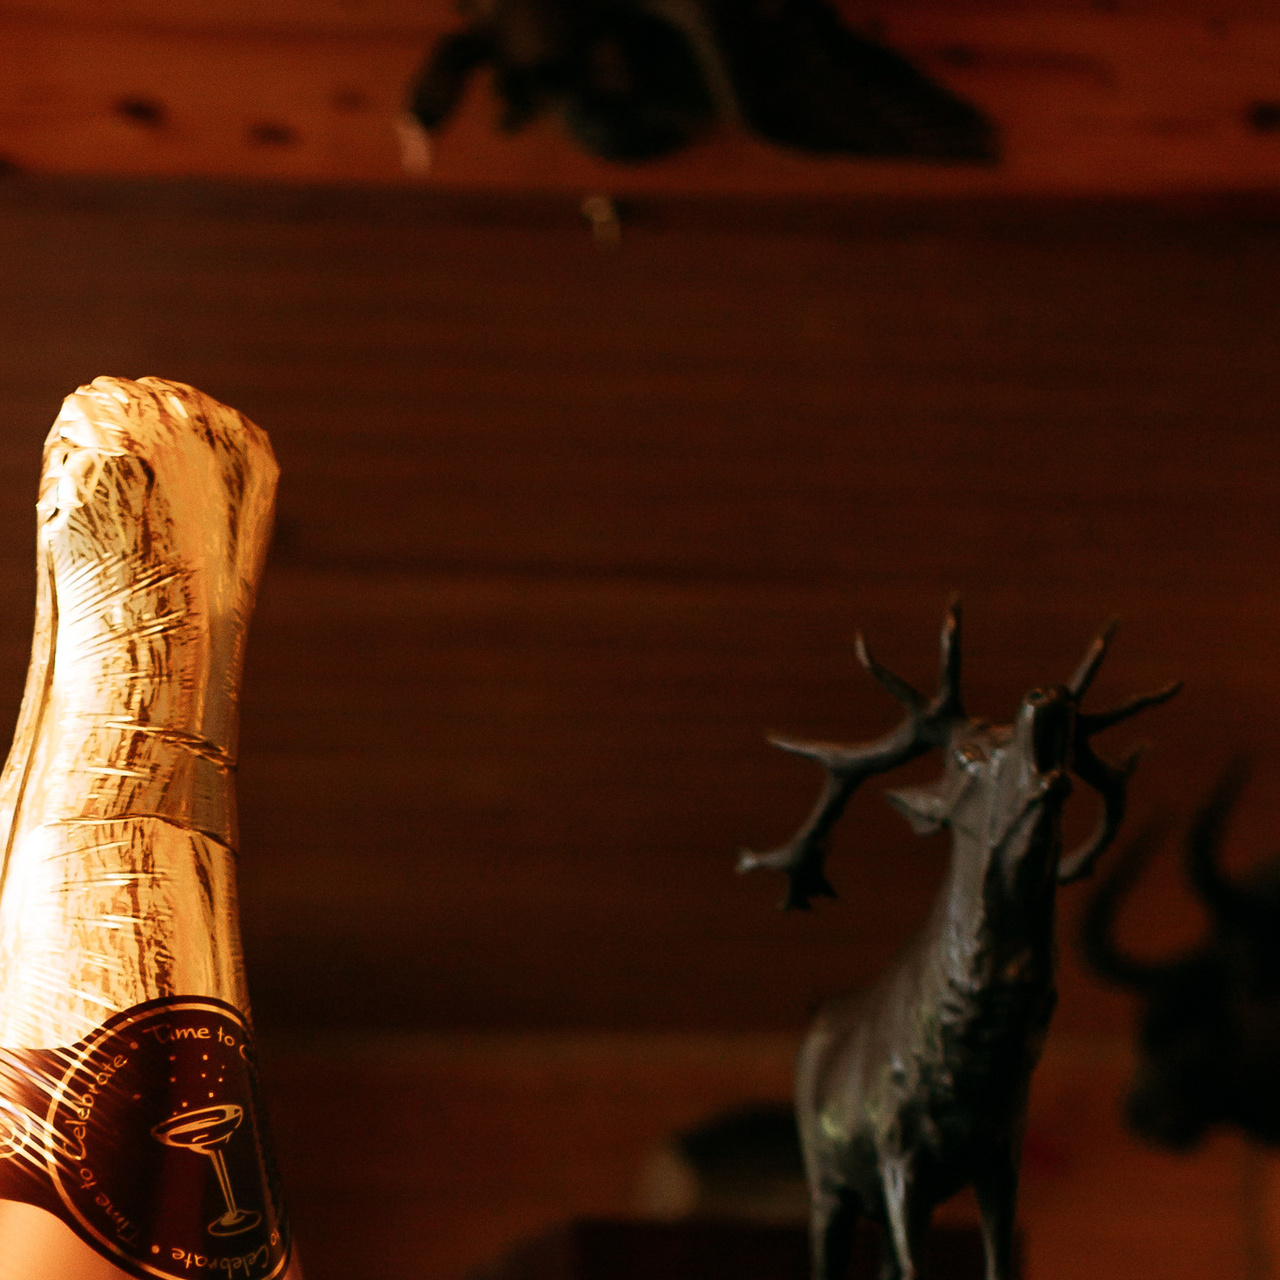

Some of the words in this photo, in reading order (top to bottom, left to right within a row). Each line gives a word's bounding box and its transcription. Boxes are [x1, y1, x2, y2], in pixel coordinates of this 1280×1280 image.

[217, 1026, 235, 1047] to
[63, 1054, 128, 1161] Celebrate
[80, 1168, 96, 1190] to
[171, 1245, 270, 1280] Celebrate
